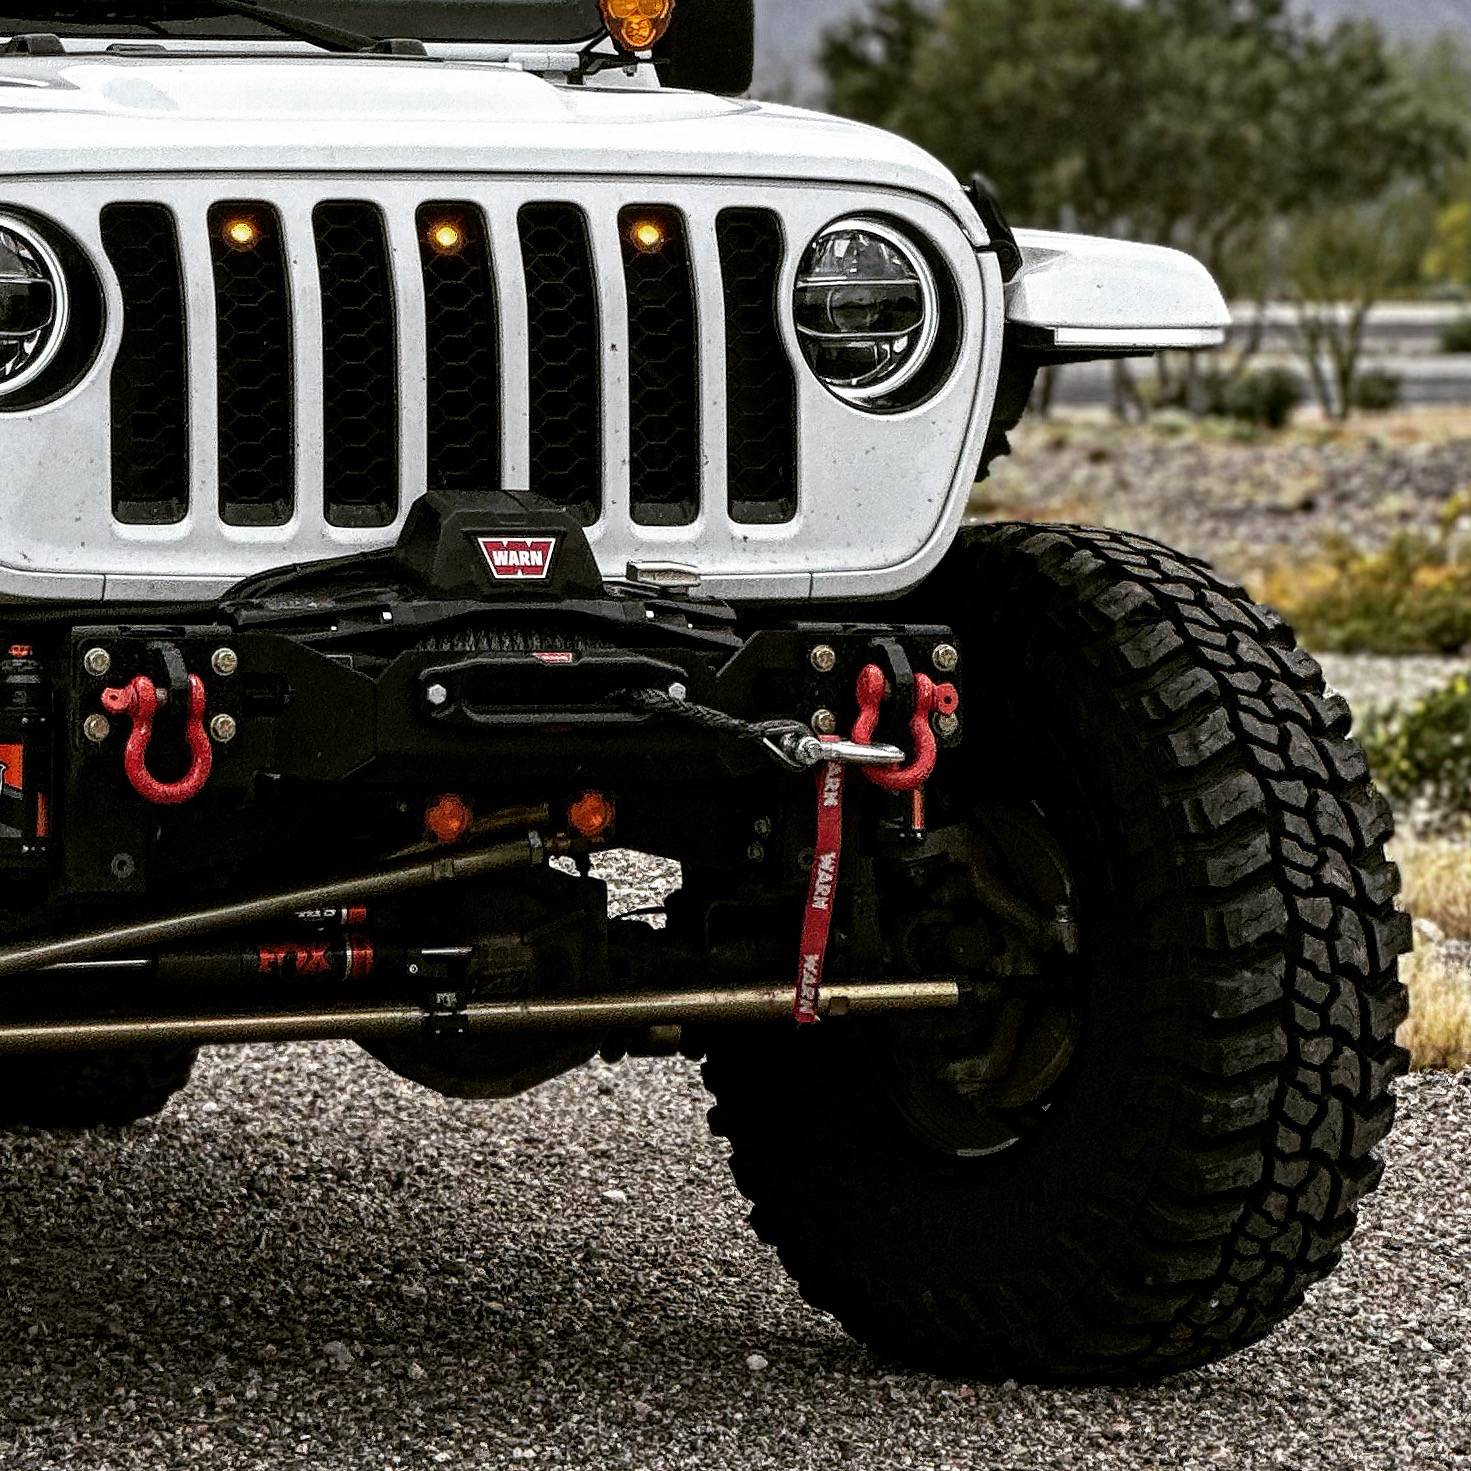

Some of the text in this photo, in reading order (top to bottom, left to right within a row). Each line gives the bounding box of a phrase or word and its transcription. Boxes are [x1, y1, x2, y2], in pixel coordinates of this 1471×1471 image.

[492, 549, 544, 567] WARN
[823, 761, 841, 807] ARN
[811, 851, 837, 910] WARN
[798, 953, 820, 1013] WARN
